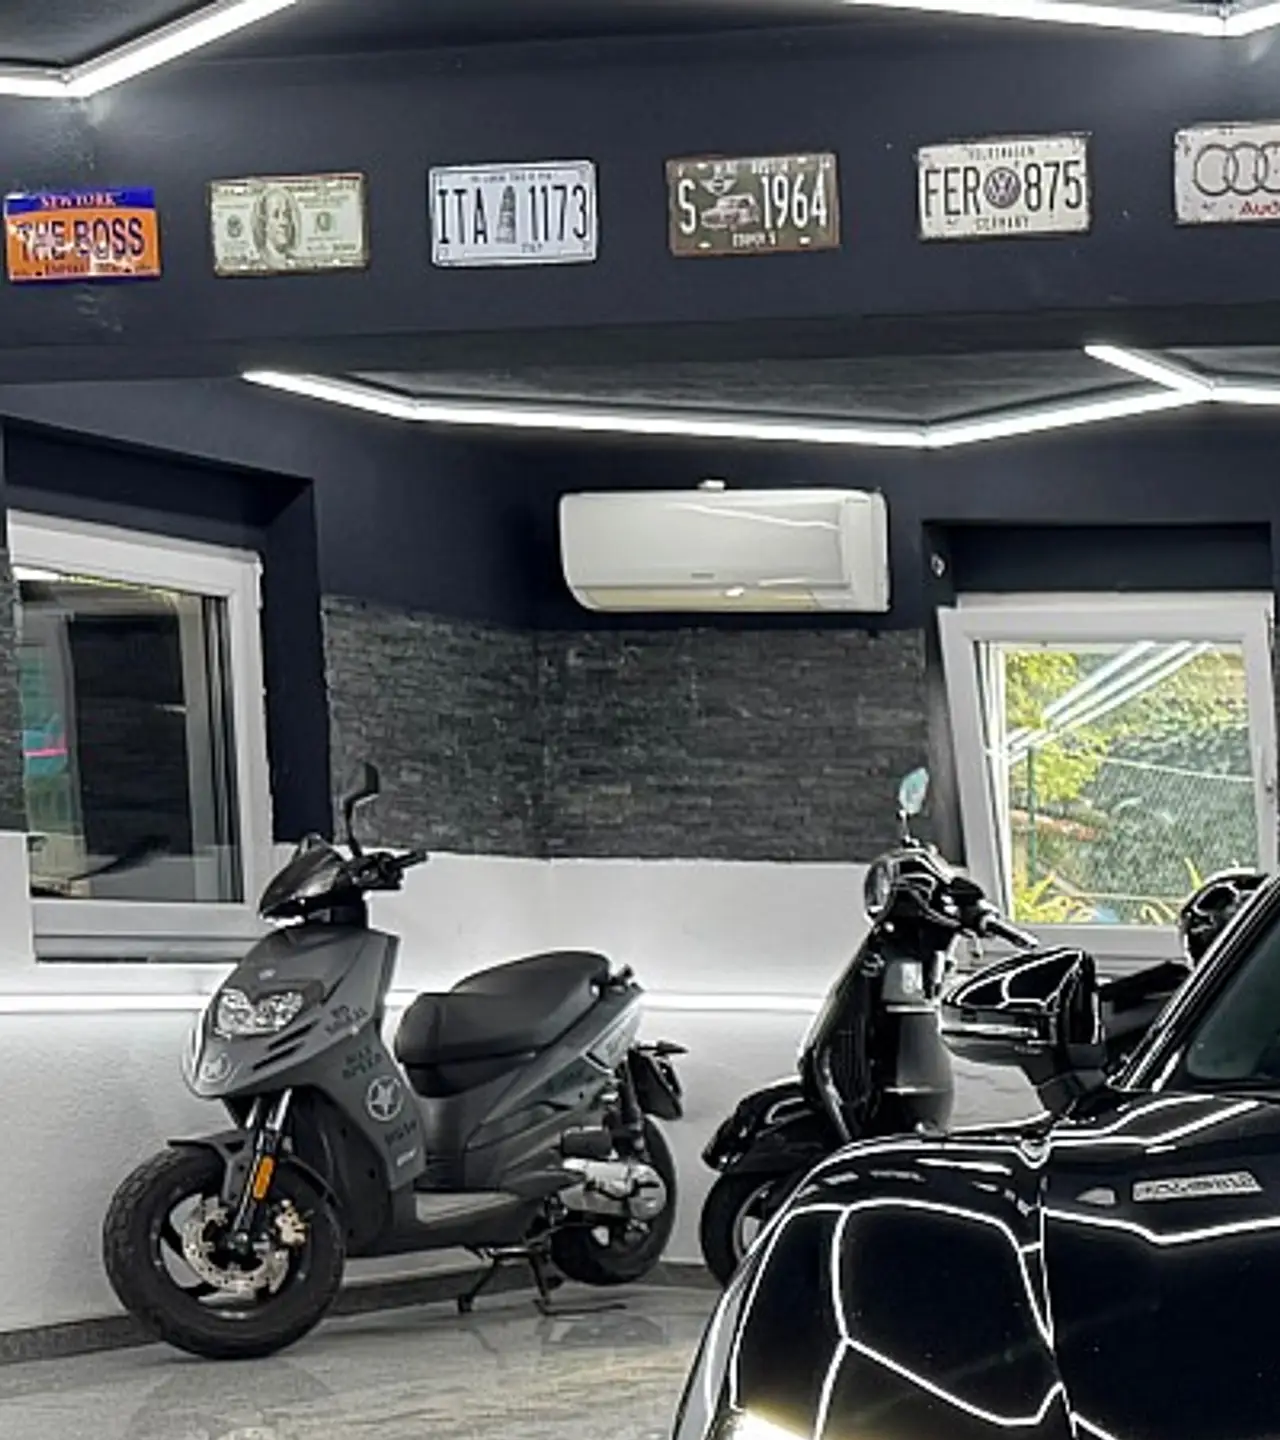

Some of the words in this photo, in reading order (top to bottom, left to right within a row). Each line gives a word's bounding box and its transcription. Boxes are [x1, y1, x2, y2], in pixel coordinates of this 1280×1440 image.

[438, 186, 488, 244] ITA
[529, 185, 587, 241] 1173
[678, 178, 696, 234] S
[761, 168, 827, 229] 1964
[925, 166, 981, 219] FER
[1024, 160, 1082, 212] 875
[17, 221, 66, 261] THE
[74, 217, 145, 259] BOSS
